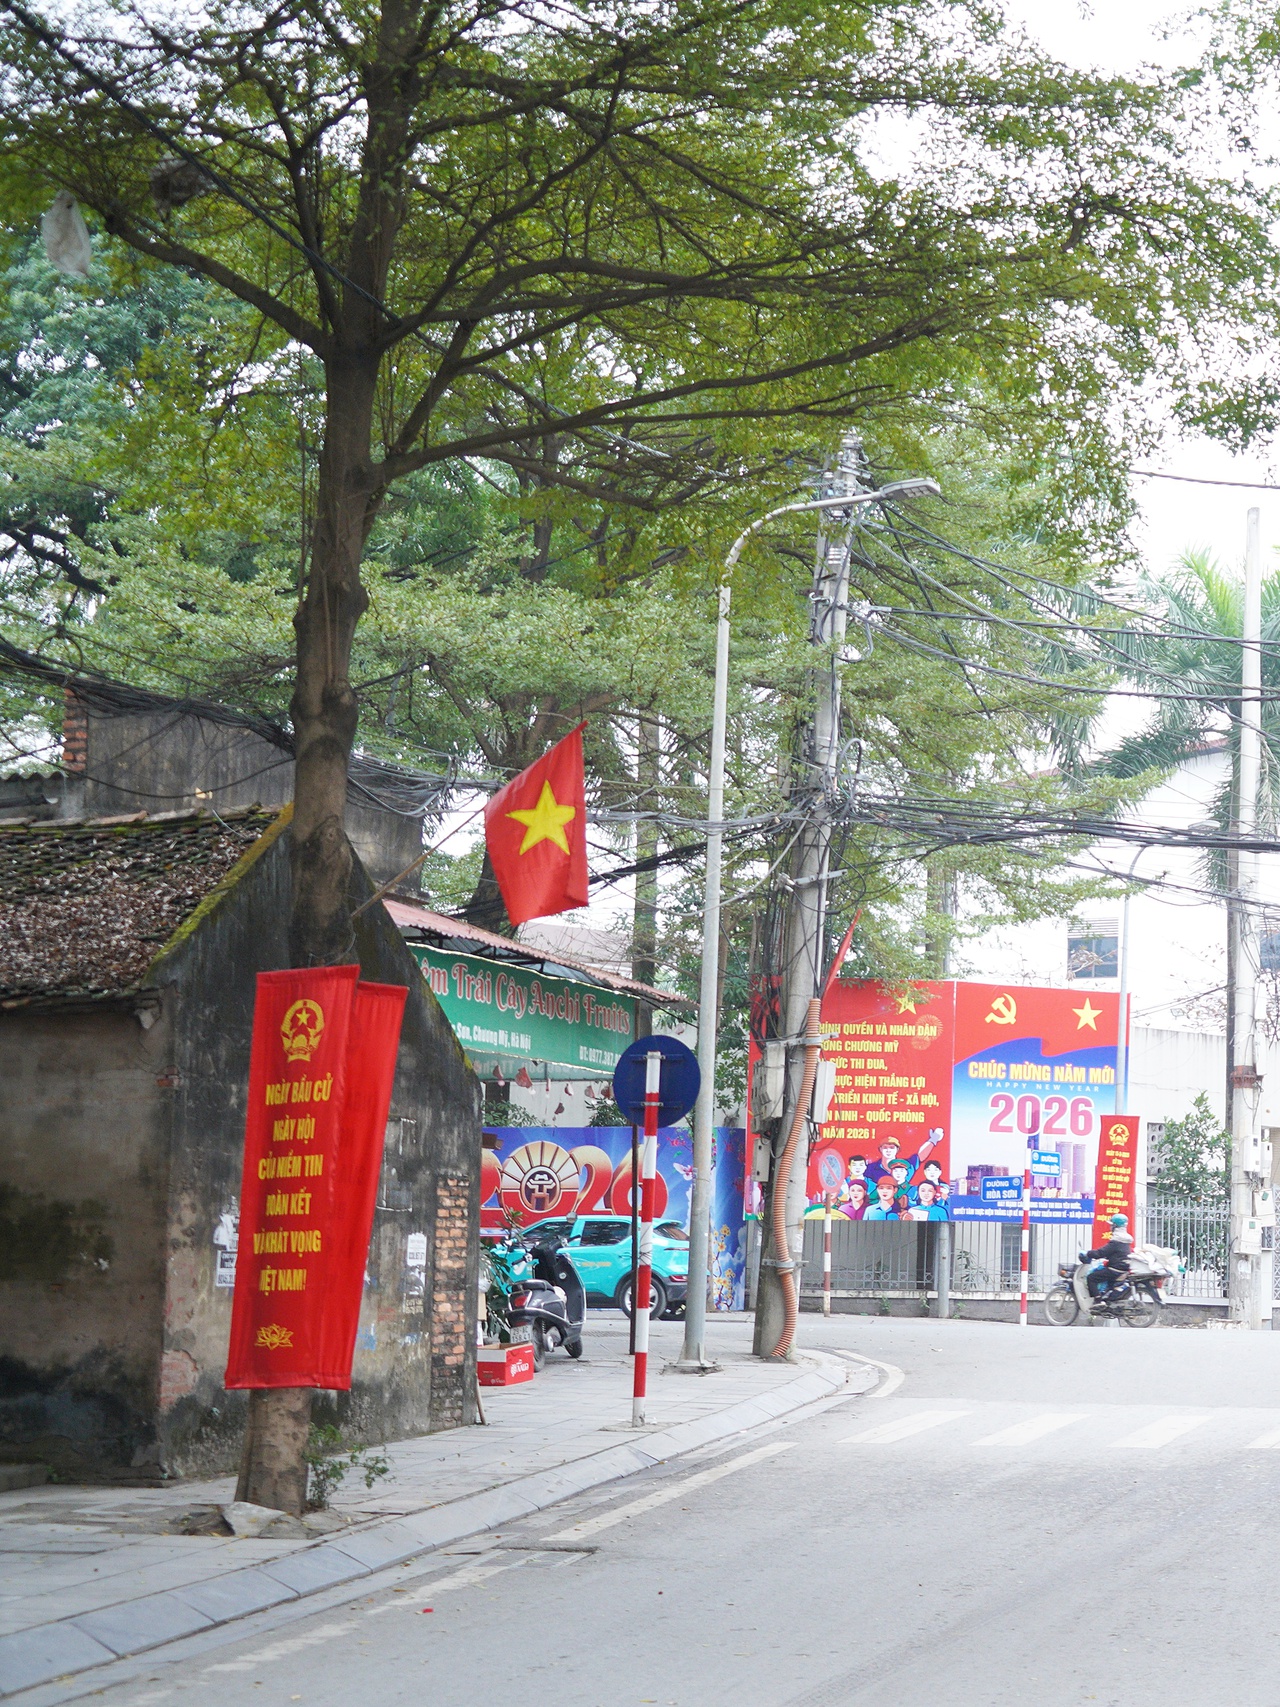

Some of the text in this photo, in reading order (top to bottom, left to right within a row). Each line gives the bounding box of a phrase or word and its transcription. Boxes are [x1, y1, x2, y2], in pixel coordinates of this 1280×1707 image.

[452, 962, 492, 1005] Trái
[495, 972, 528, 1019] Cây
[528, 981, 580, 1024] Anchi
[582, 993, 630, 1035] Fruits
[819, 1021, 937, 1037] HÍNH QUYỀN VÀ NHÂN DÂN
[511, 1031, 519, 1048] Hà
[845, 1040, 882, 1052] CHƯƠNG
[884, 1039, 899, 1053] MỸ
[850, 1058, 864, 1069] THI
[867, 1059, 888, 1070] ĐUA,
[968, 1060, 1115, 1085] CHÚC MỪNG NĂM MỚI
[291, 1073, 312, 1103] BẦU
[312, 1071, 334, 1102] CỬ
[834, 1073, 926, 1090] HỰC HIỆN THẮNG LỢI
[833, 1089, 861, 1104] TRIỂN
[862, 1093, 884, 1104] KINH
[886, 1091, 899, 1105] TẾ
[906, 1092, 919, 1105] XÃ
[921, 1092, 940, 1108] HỘI,
[835, 1110, 858, 1121] NINH
[866, 1107, 891, 1123] QUỐC
[893, 1109, 925, 1123] PHÒNG
[988, 1092, 1094, 1136] 2026
[273, 1113, 316, 1144] NGÀY HỘI
[823, 1126, 845, 1139] NĂM
[847, 1128, 869, 1139] 2026
[304, 1154, 324, 1177] TIN
[986, 1180, 1009, 1188] ĐƯỜNG
[986, 1189, 1018, 1198] HÒA SƠN
[290, 1186, 312, 1215] KẾT
[290, 1230, 322, 1258] VỌNG
[278, 1268, 307, 1291] NAM!
